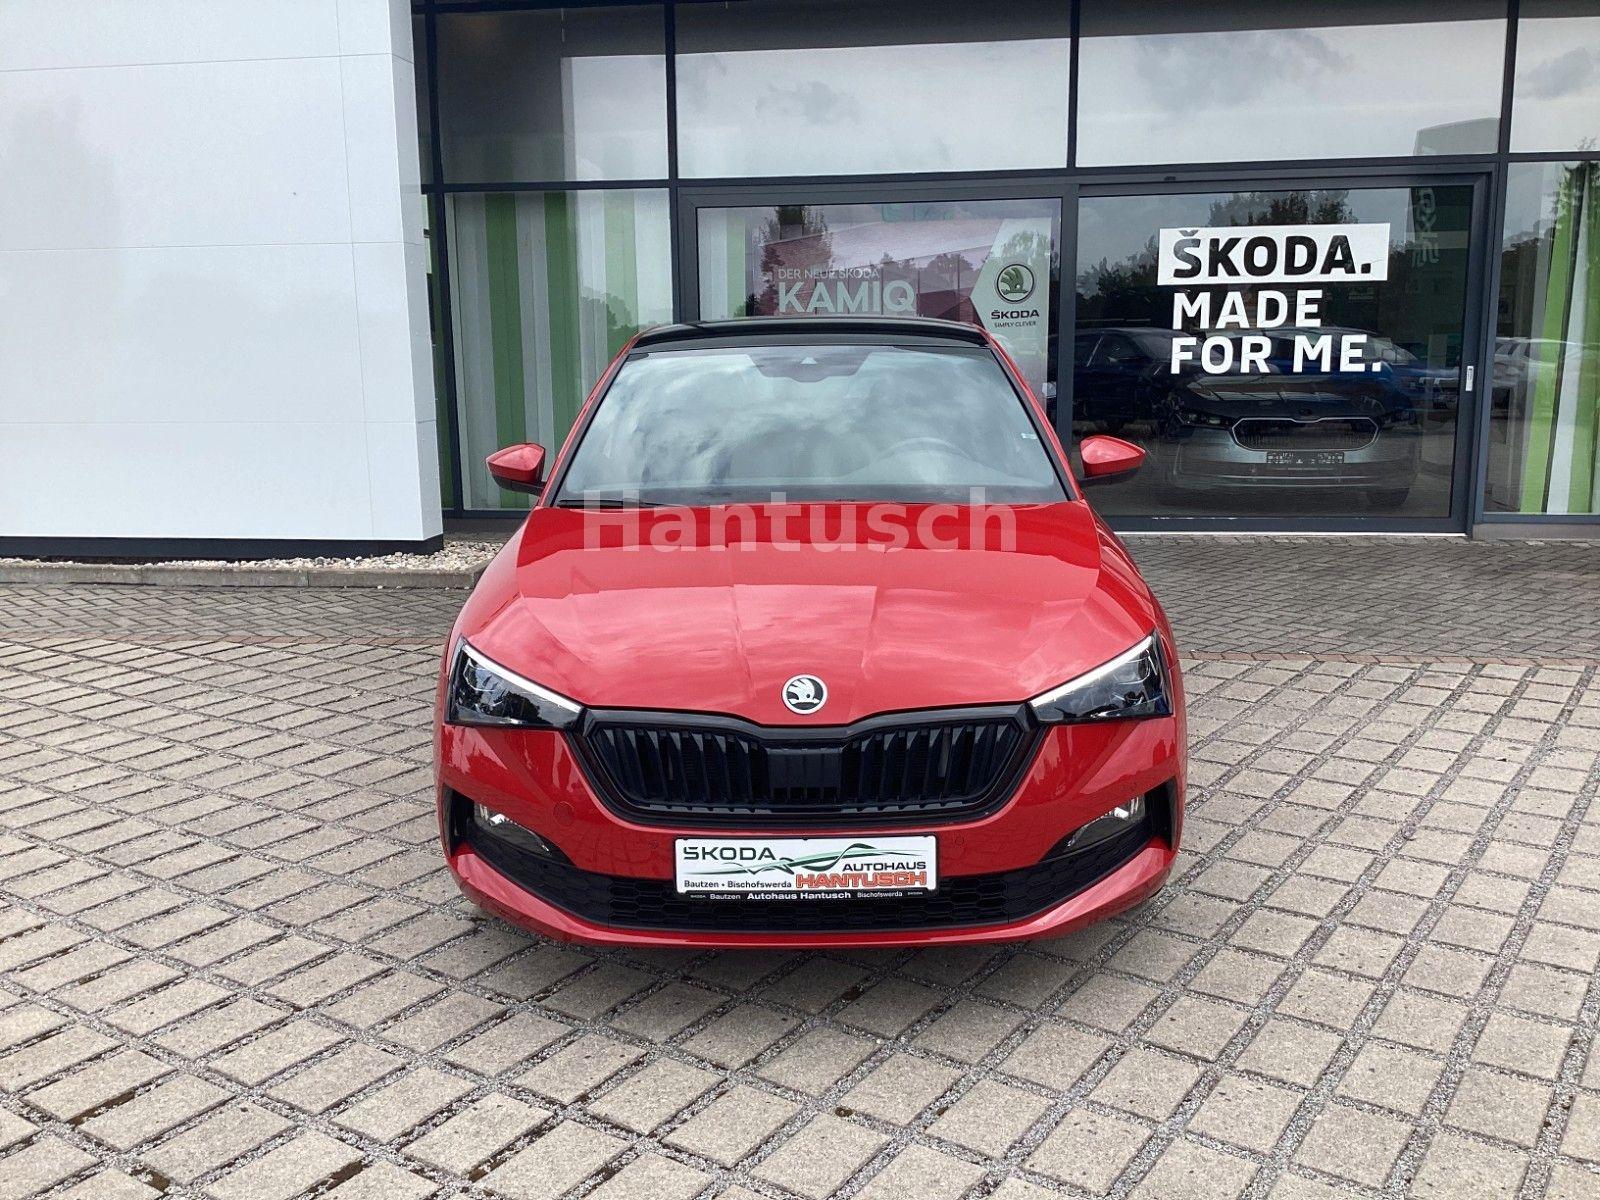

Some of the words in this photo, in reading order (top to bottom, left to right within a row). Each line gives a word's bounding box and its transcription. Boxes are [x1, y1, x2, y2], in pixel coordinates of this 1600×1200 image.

[1173, 229, 1372, 279] ŠKODA.
[778, 268, 801, 279] DER
[778, 280, 917, 313] KAMIQ
[991, 309, 1040, 320] ŠKODA
[1172, 289, 1323, 330] MADE
[1170, 335, 1271, 375] FOR
[1292, 334, 1382, 373] ME.
[842, 861, 926, 871] AUTOHAUS
[684, 880, 719, 888] Bautzen
[727, 880, 792, 888] Bischofswerda
[796, 871, 928, 889] HANTUSCH
[800, 891, 851, 899] Hantusch
[857, 890, 903, 898] Bischofswerda
